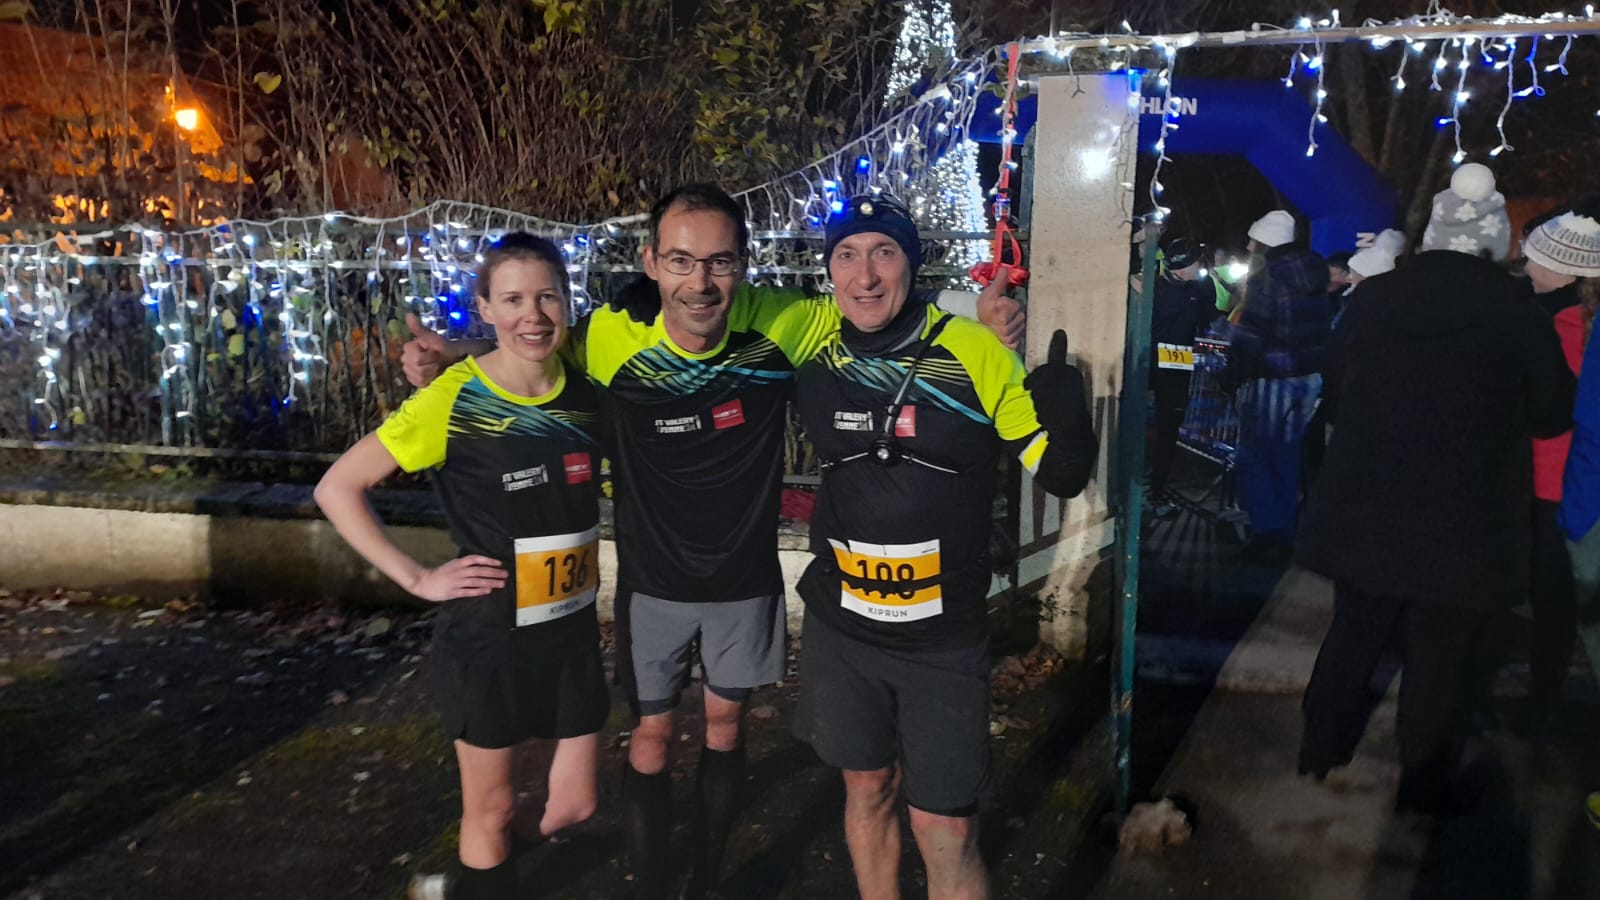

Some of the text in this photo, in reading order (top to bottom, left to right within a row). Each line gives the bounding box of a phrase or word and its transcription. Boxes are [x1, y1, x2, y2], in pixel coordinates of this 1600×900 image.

[1140, 97, 1197, 115] HLON
[1166, 350, 1185, 362] 191
[544, 549, 589, 597] 136
[867, 606, 908, 618] KIPRUN
